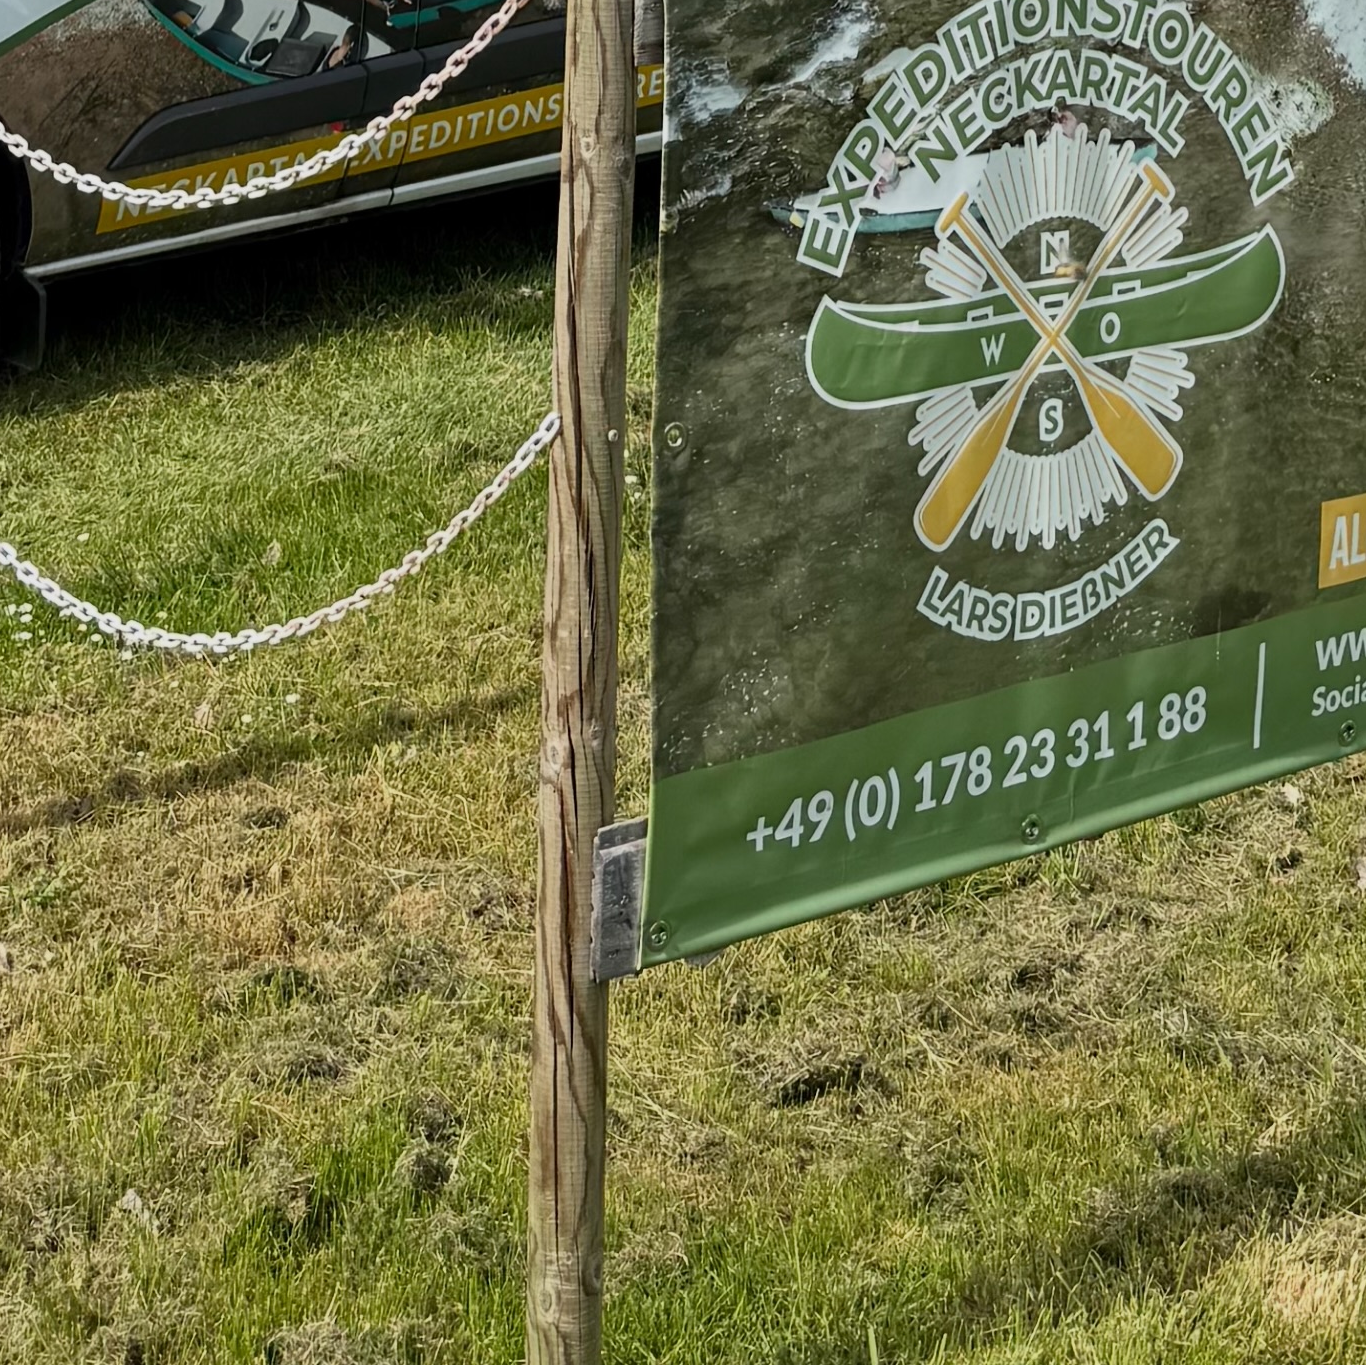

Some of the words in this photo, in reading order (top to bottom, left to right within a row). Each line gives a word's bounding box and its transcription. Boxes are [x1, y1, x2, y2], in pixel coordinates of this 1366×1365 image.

[908, 49, 1190, 182] NECKARTAL
[1043, 233, 1066, 270] N
[981, 332, 1005, 367] W
[1100, 312, 1121, 344] O
[1042, 402, 1060, 437] S
[920, 570, 1012, 638] LARS
[746, 790, 834, 851] +49
[845, 767, 900, 842] (0)
[914, 745, 992, 812] 178
[1002, 728, 1055, 788] 23
[1065, 711, 1114, 768] 31
[1126, 701, 1148, 751] 1
[1157, 686, 1207, 740] 88
